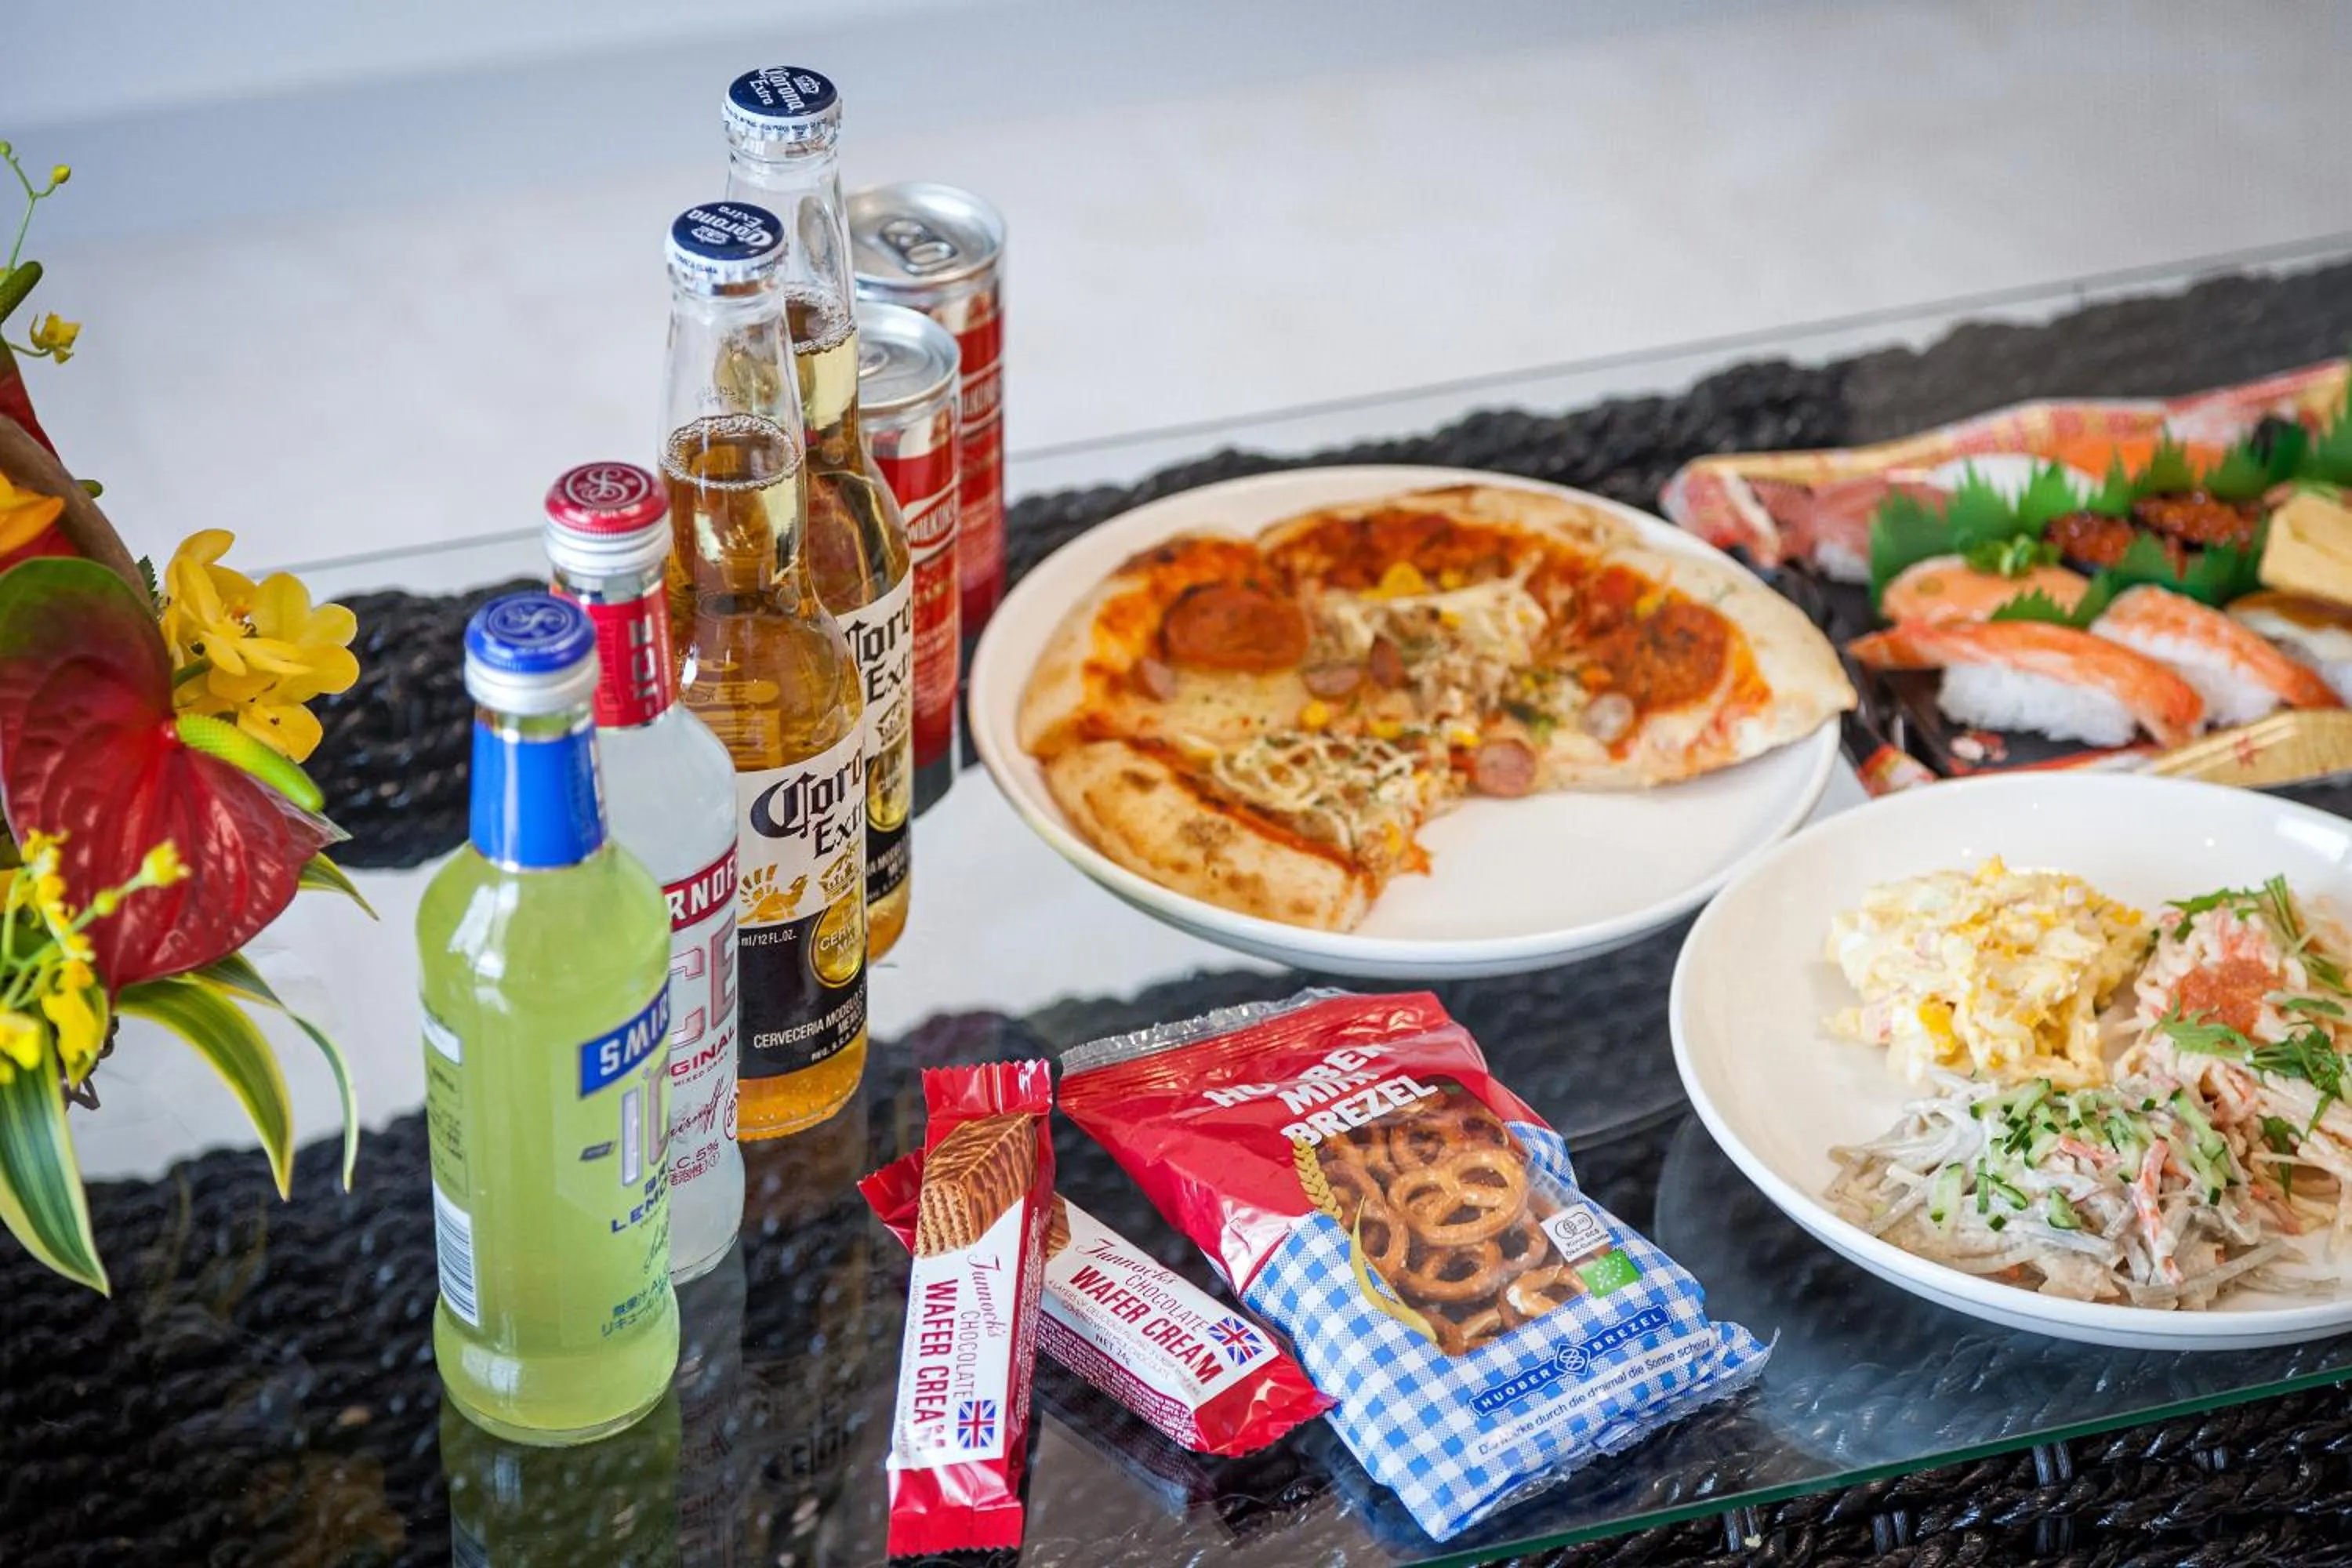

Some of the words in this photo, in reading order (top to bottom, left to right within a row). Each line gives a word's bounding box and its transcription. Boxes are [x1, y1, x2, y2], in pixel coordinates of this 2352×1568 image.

[750, 78, 774, 105] Extra
[758, 66, 805, 113] Corona
[687, 209, 773, 247] Corona
[718, 205, 765, 229] Extra
[753, 1018, 824, 1049] CERVECERIA
[1280, 1074, 1439, 1145] BREZEL
[919, 1279, 959, 1358] WAFER
[1069, 1265, 1152, 1326] WAFER
[1142, 1318, 1225, 1385] CREAM
[1124, 1275, 1208, 1334] CHOCOLATE
[953, 1310, 981, 1399] CHOCOLATE
[1592, 1313, 1661, 1351] BREZEL
[1481, 1368, 1552, 1408] HUOBER
[1535, 1402, 1569, 1426] durch
[1569, 1394, 1586, 1409] die
[1628, 1364, 1645, 1379] die
